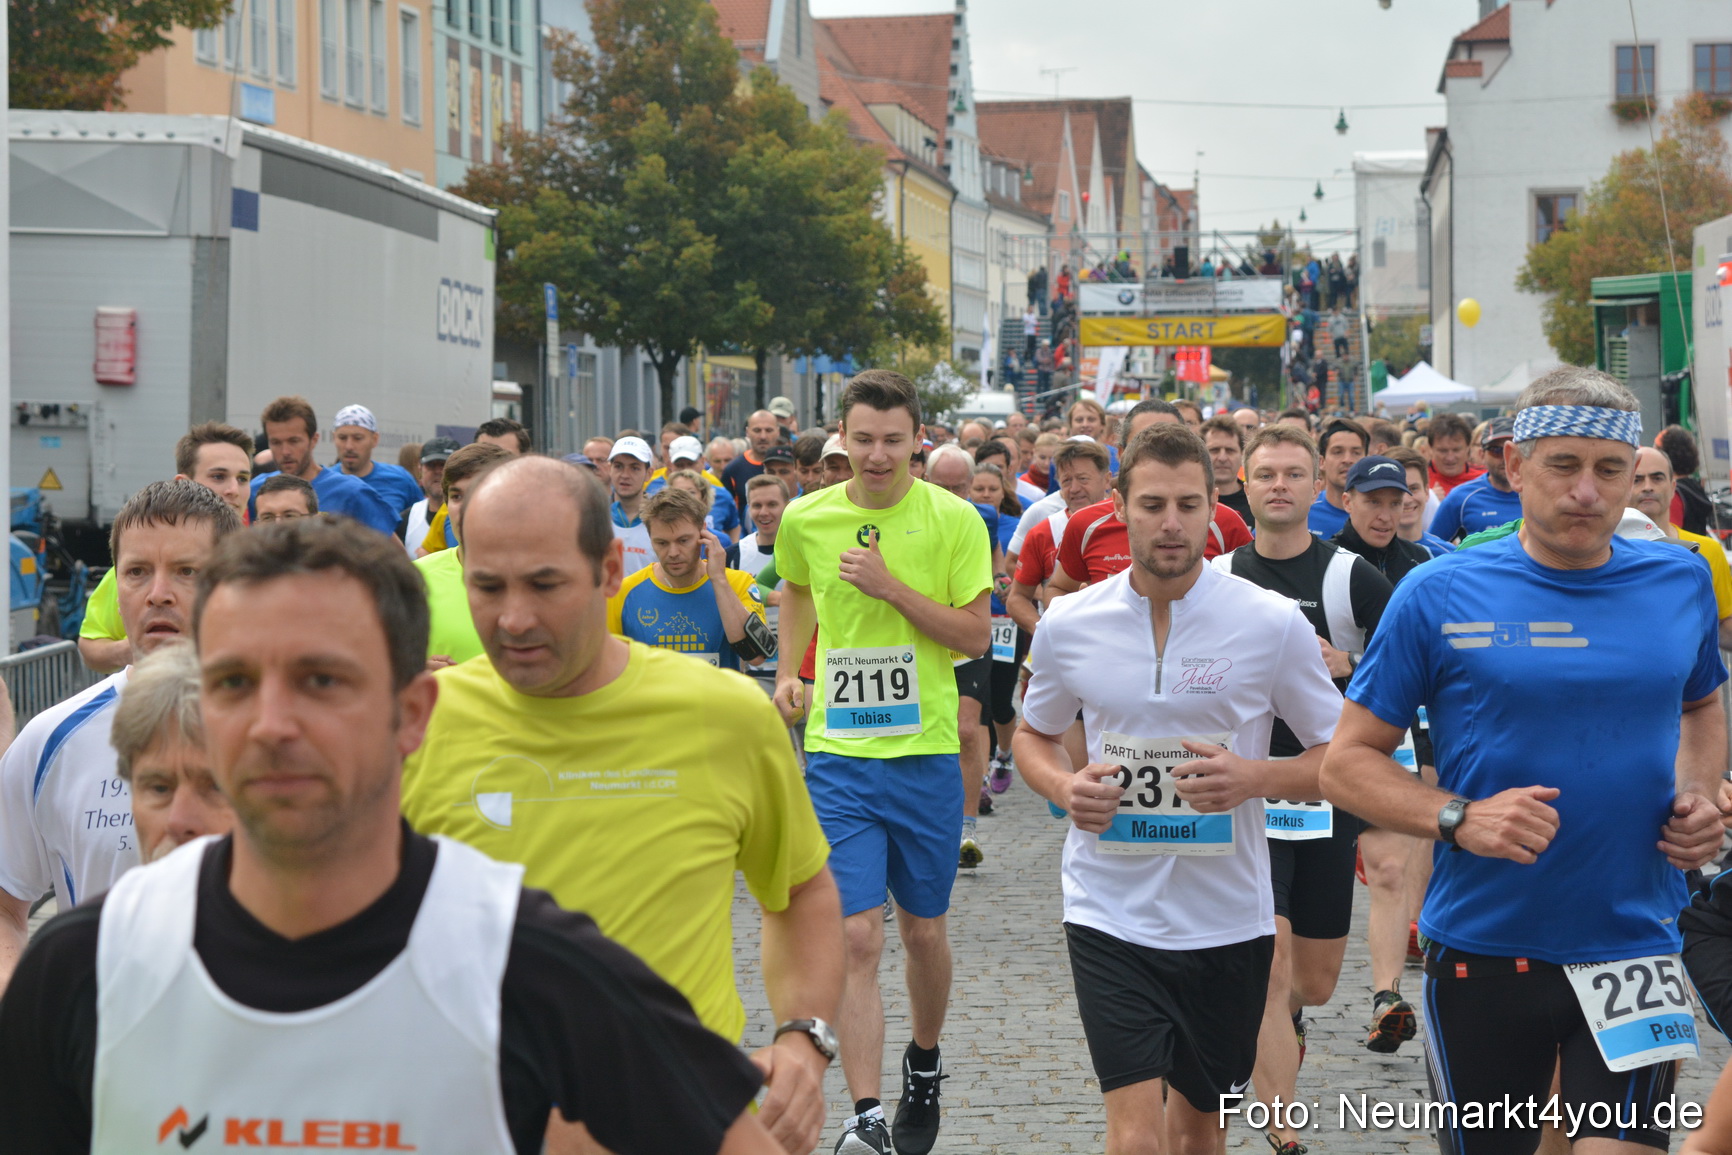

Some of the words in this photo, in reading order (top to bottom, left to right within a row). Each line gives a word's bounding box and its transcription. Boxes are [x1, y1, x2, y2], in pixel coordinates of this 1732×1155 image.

[437, 278, 484, 348] BOCK
[1146, 321, 1218, 340] START
[827, 657, 853, 666] PARTL
[855, 655, 899, 666] Neumarkt
[833, 667, 910, 703] 2119
[1171, 657, 1233, 695] Julia
[850, 711, 892, 725] Tobias
[1104, 743, 1140, 760] PARTL
[558, 770, 601, 781] Kliniken
[100, 777, 128, 798] 19.
[590, 780, 641, 791] Neumarkt
[1131, 820, 1197, 840] Manuel
[117, 835, 132, 851] 5.
[223, 1117, 418, 1152] KLEBL
